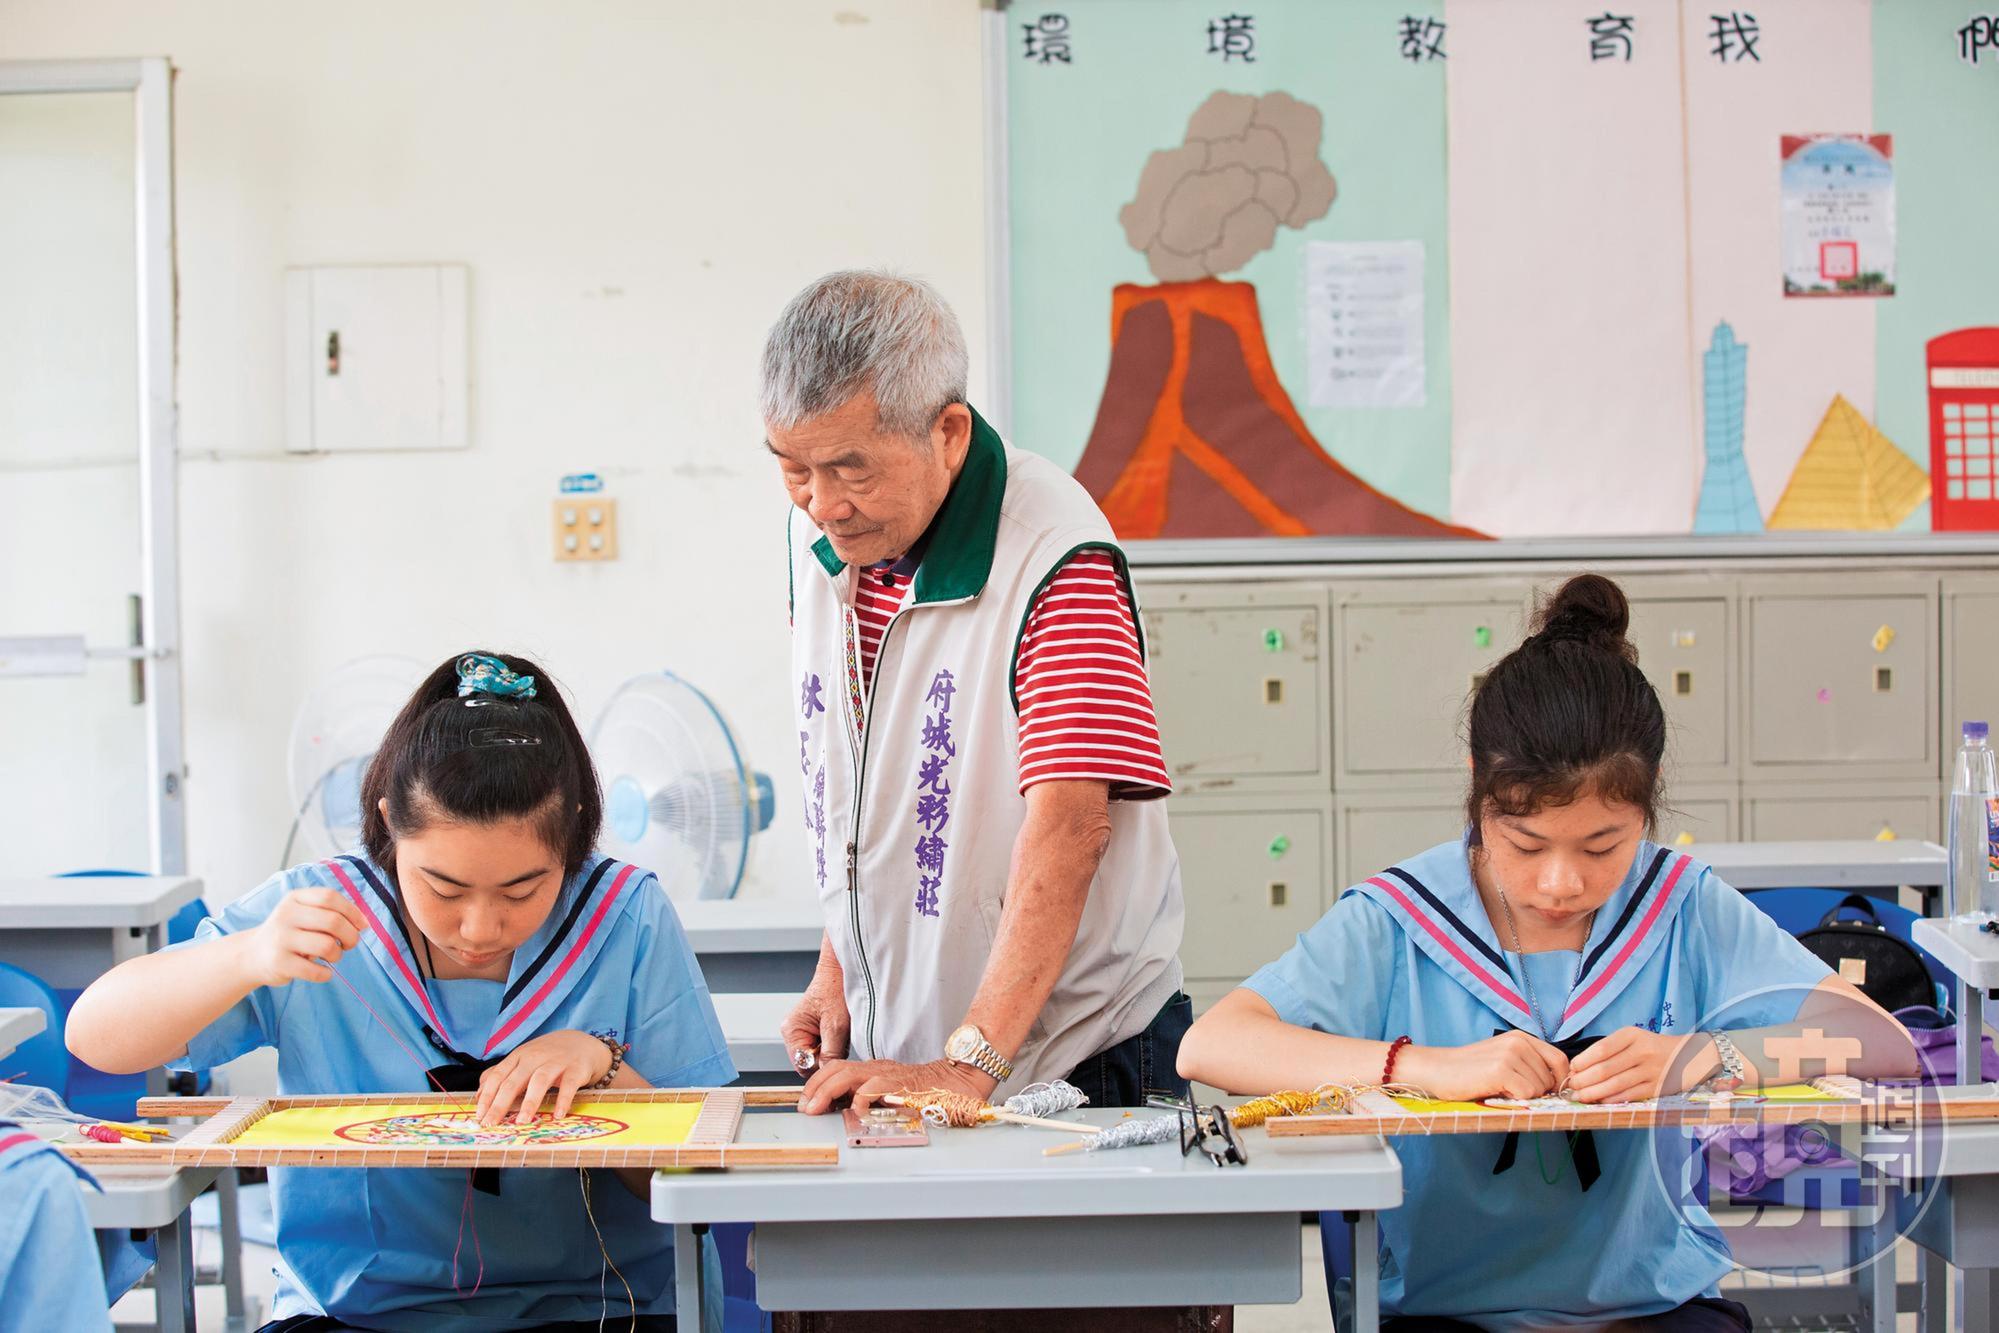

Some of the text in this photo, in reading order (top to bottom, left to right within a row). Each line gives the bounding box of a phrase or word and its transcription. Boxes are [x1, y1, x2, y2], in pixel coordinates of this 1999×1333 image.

[914, 668, 956, 917] 府城光彩繡莊
